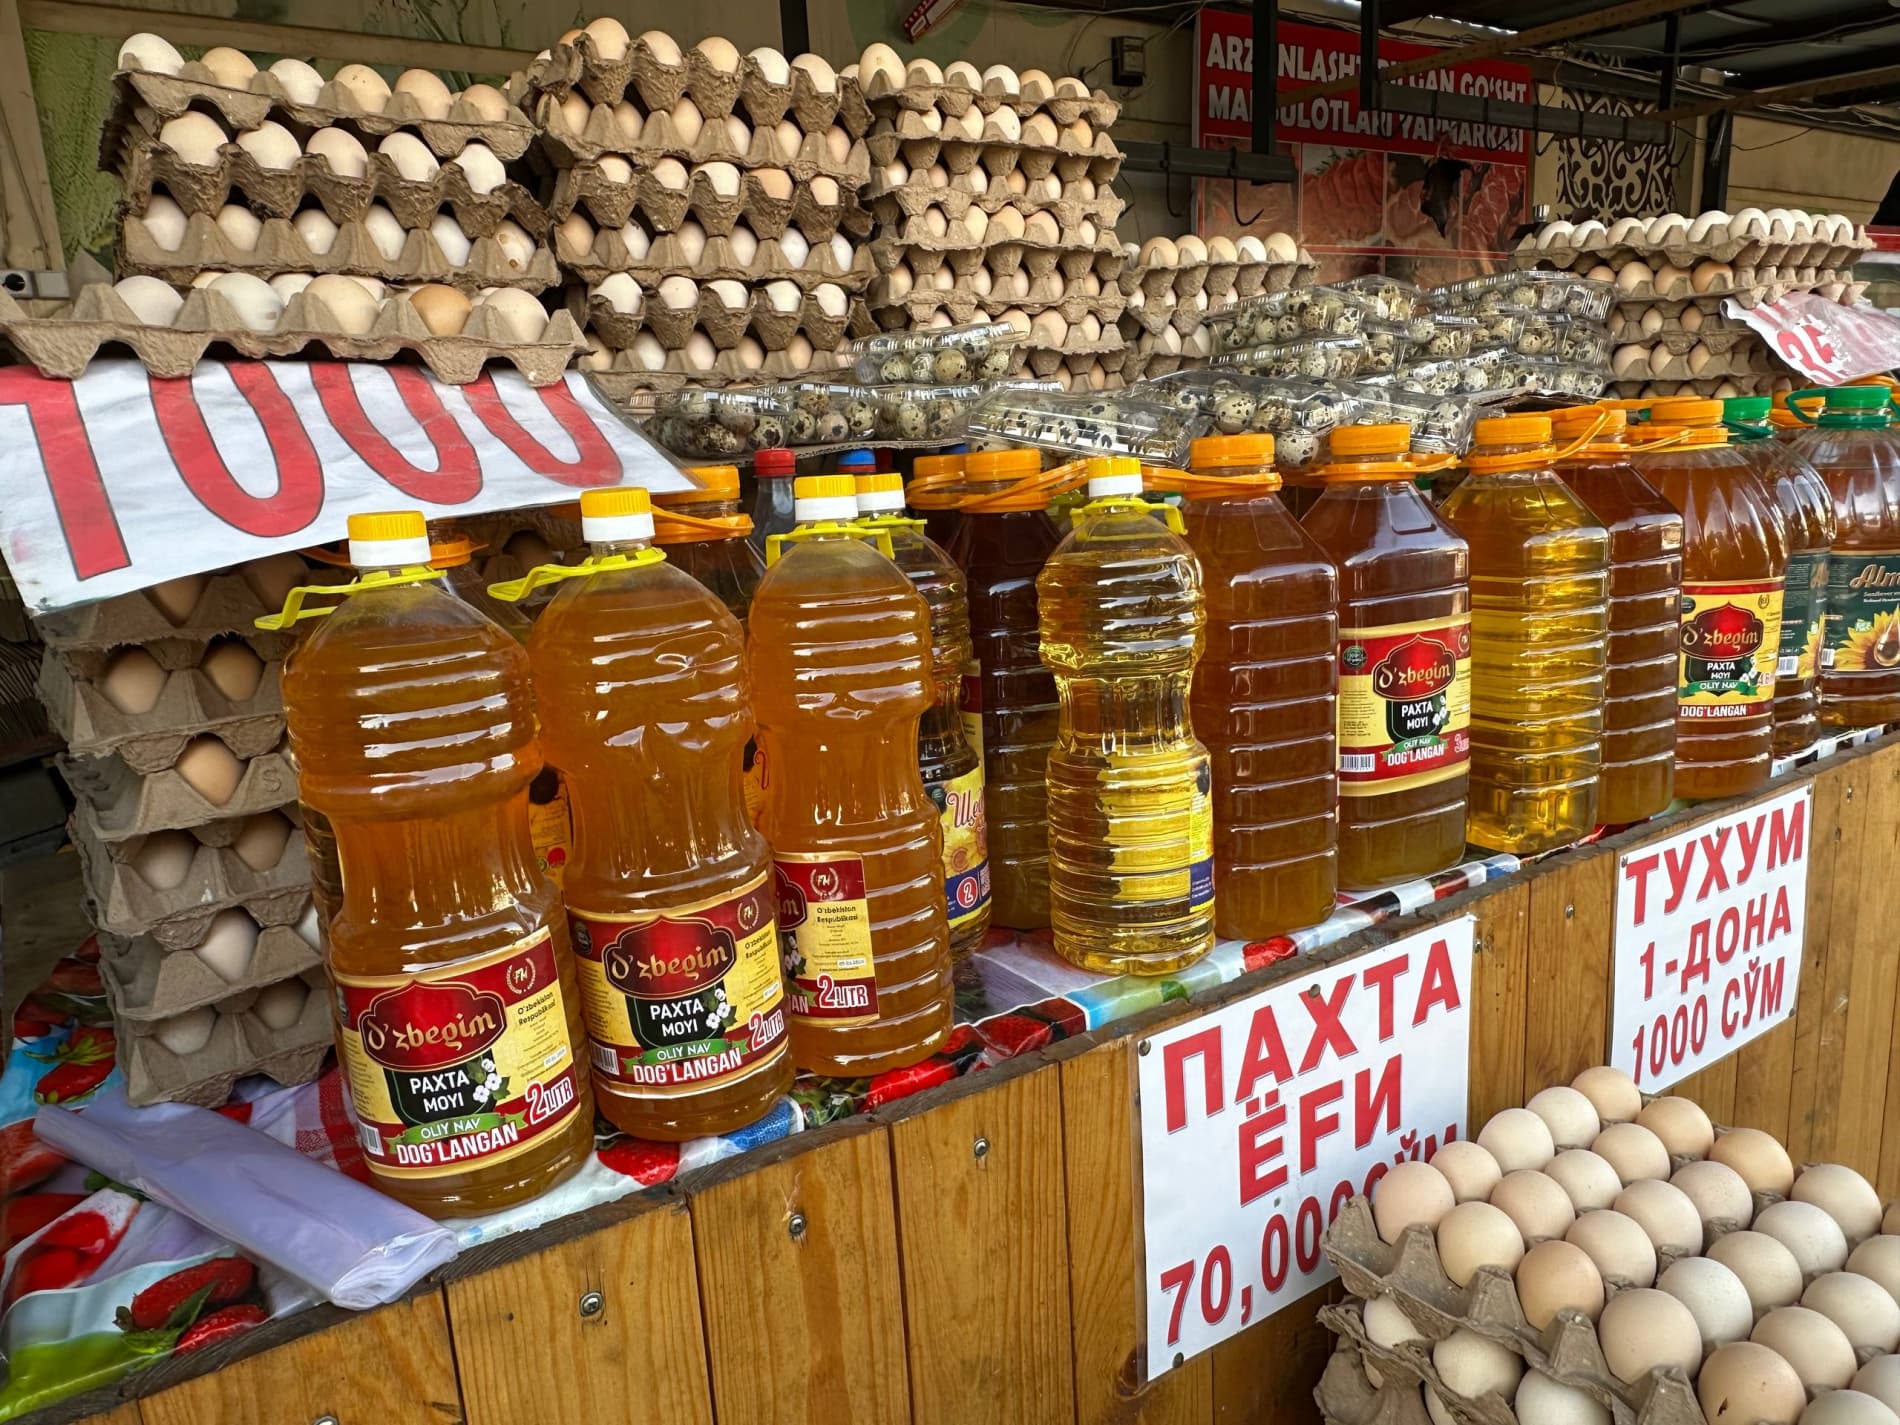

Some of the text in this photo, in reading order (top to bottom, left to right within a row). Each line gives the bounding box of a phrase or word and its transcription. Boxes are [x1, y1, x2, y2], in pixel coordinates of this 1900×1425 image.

[1706, 661, 1736, 672] PAXTA
[1711, 671, 1731, 680] MOYI
[1401, 700, 1434, 718] PAXTA
[1406, 716, 1429, 731] MOYI
[1625, 799, 1806, 927] ТУХУМ
[1640, 884, 1792, 1002] 1-ДОНА
[649, 998, 705, 1020] PAXTA
[661, 1018, 698, 1038] MOYI
[1632, 955, 1785, 1086] 1000 СЎМ
[1162, 938, 1462, 1135] ПАХТА
[656, 1041, 712, 1061] OLIY NAV
[632, 1047, 743, 1084] DOG'LANGAN
[409, 1069, 471, 1095] PAXTA
[423, 1092, 465, 1113] MOYI
[420, 1117, 482, 1139] OLIY NAV
[395, 1121, 519, 1165] DOG'LANGAN
